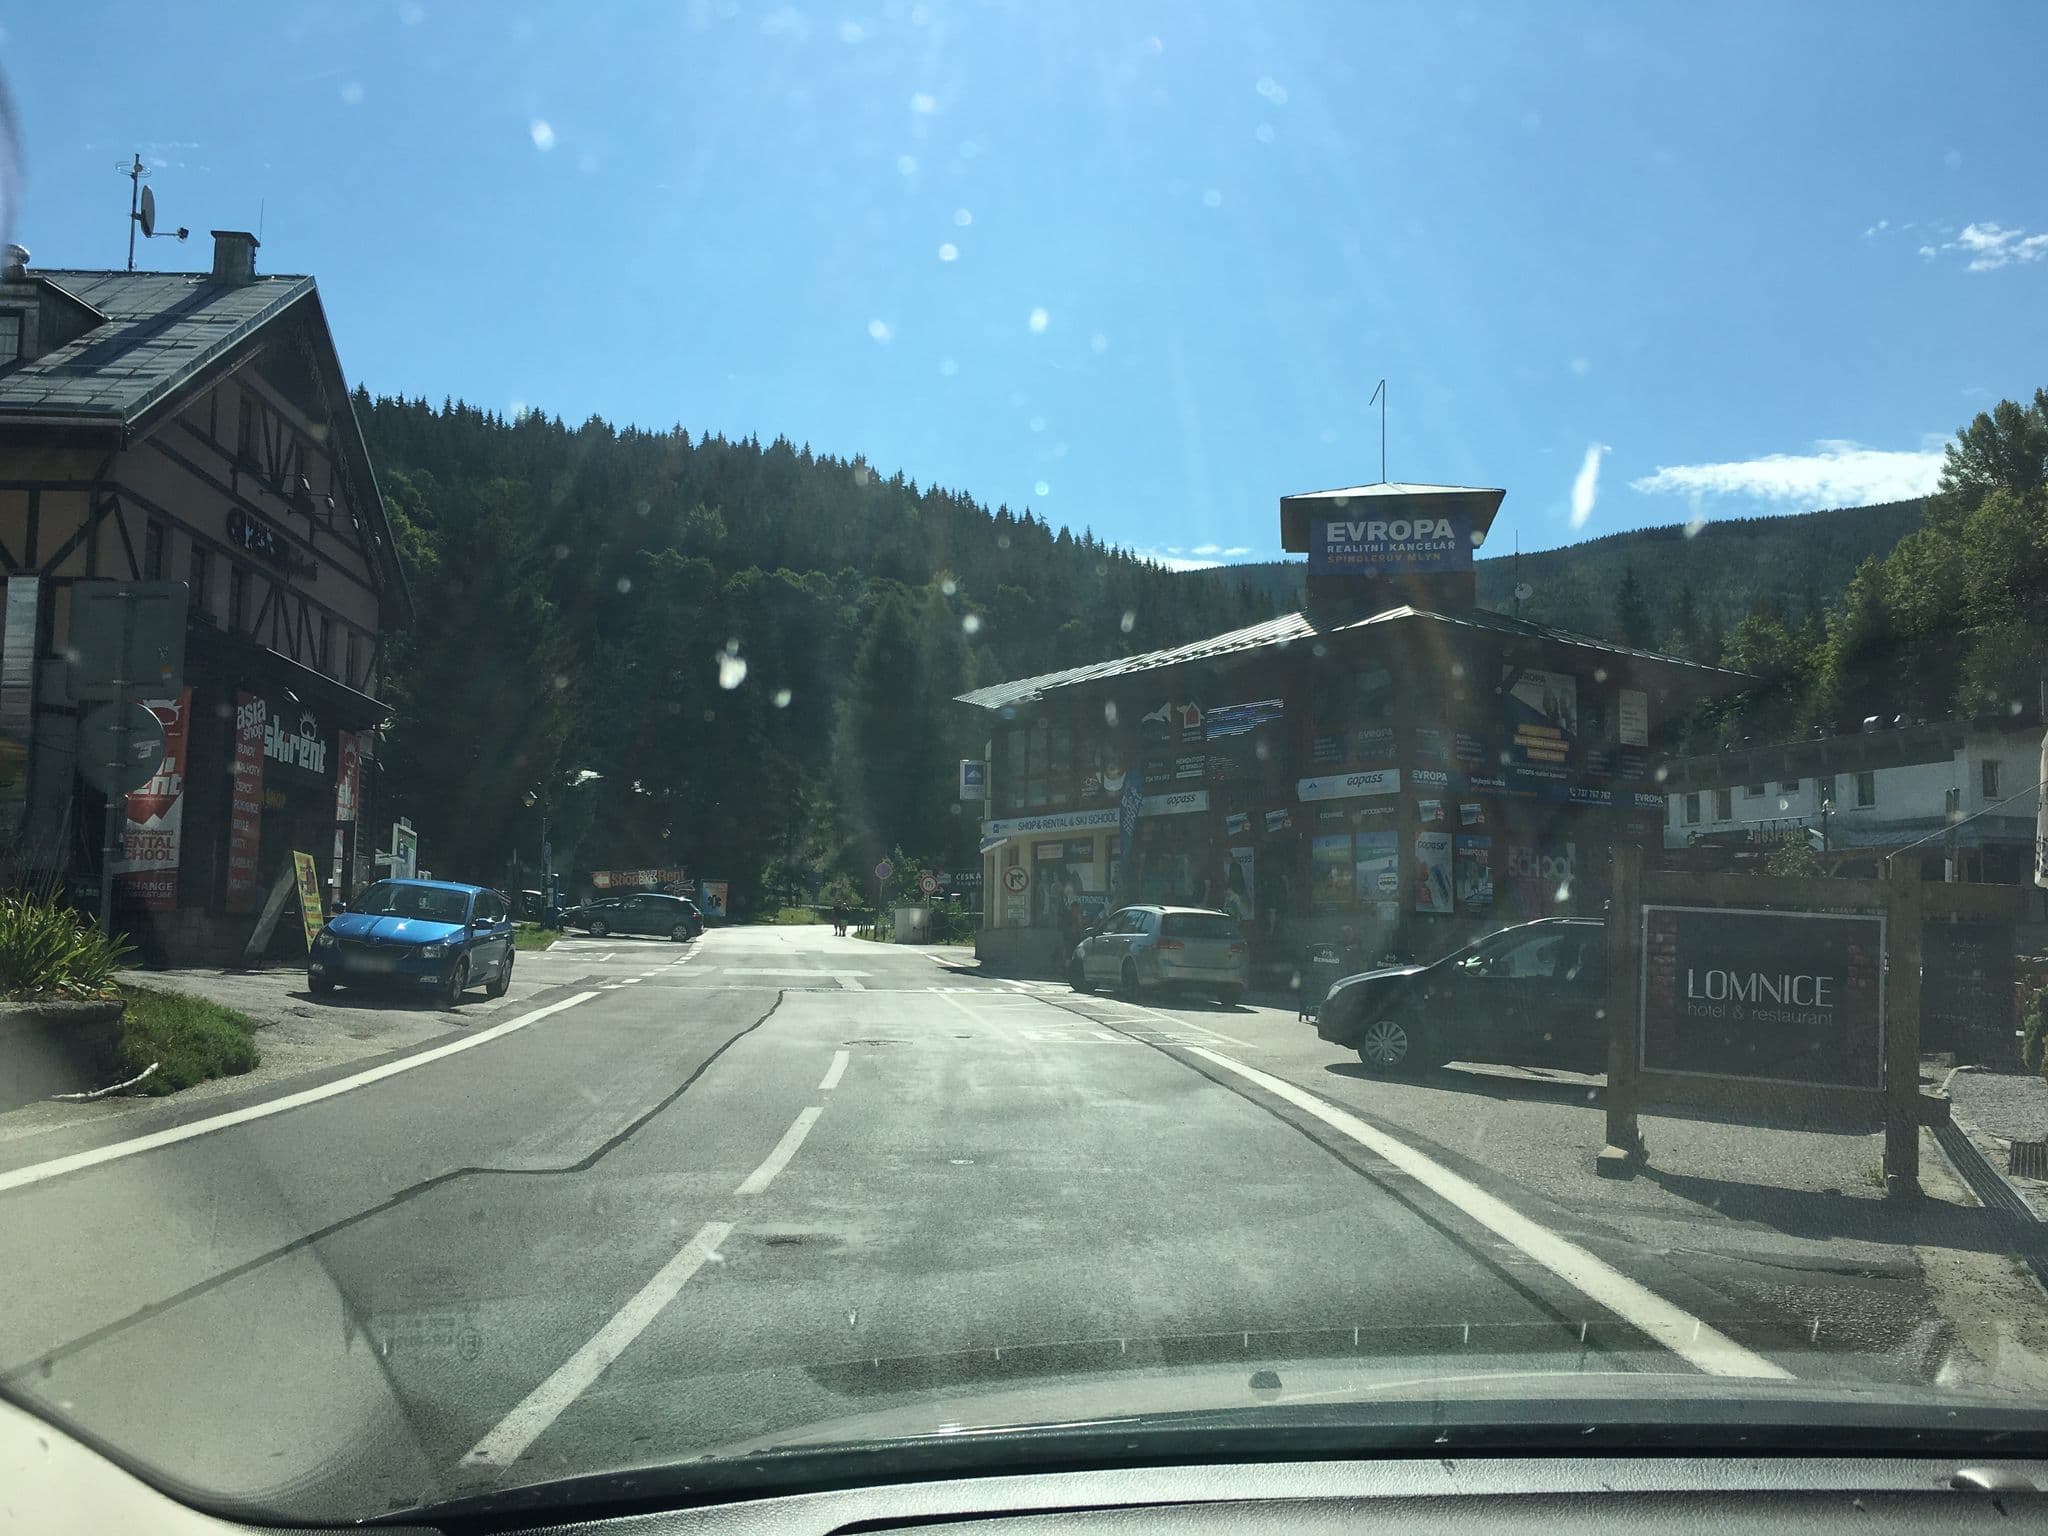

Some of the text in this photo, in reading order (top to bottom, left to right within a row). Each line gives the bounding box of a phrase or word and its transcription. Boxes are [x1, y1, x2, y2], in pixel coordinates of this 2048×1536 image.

[1327, 518, 1456, 542] EVROPA
[237, 696, 267, 730] asia
[1411, 769, 1448, 782] EVROPA
[1634, 792, 1664, 804] EVROPA
[125, 836, 176, 850] ENTAL
[1687, 967, 1834, 1009] LOMNICE
[1687, 1001, 1834, 1026] hotel & restaurant
